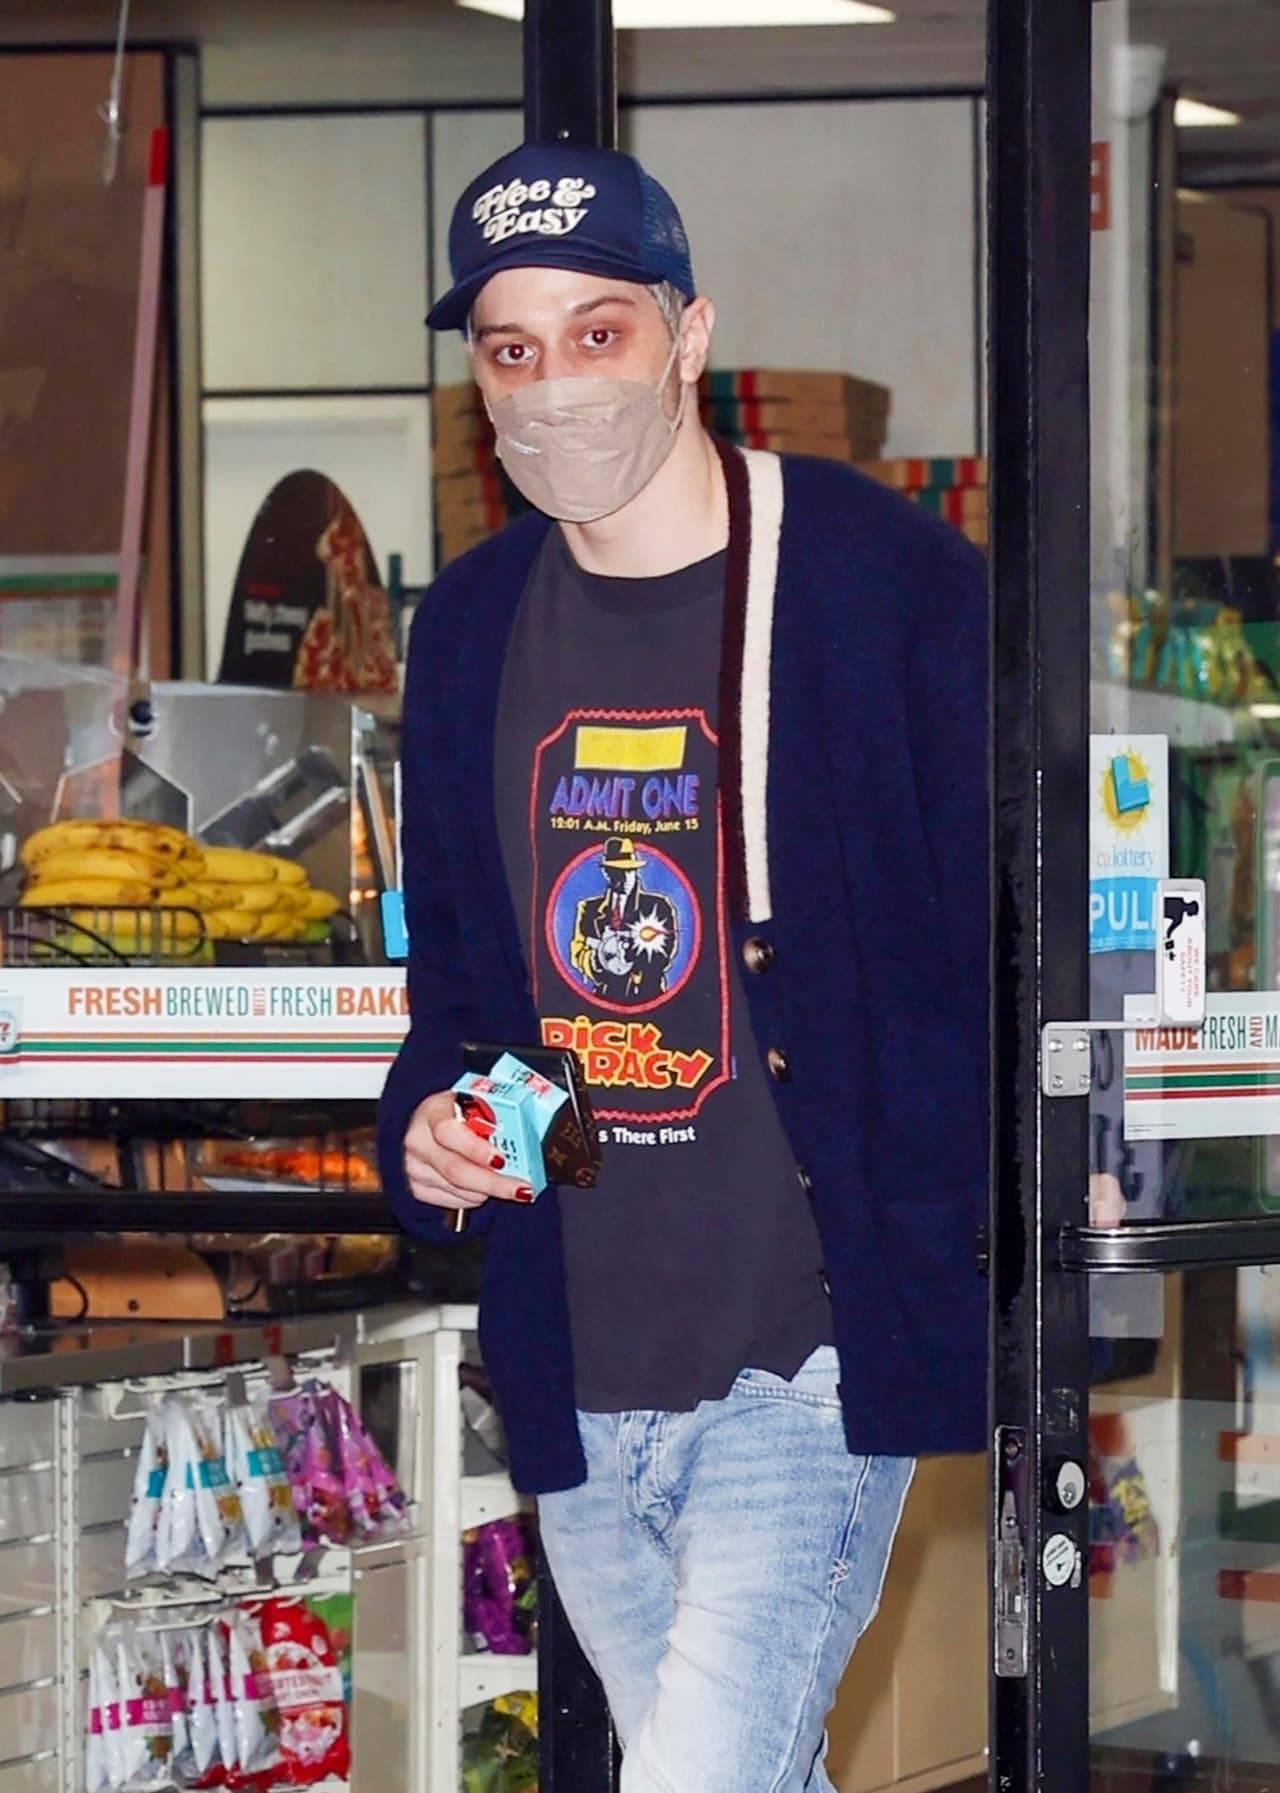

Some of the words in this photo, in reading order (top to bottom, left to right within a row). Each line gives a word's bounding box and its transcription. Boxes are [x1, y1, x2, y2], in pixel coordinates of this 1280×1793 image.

[472, 178, 551, 224] Free
[552, 177, 597, 207] &
[483, 208, 588, 245] Easy
[550, 774, 636, 818] ADMIT
[642, 773, 699, 818] ONE
[551, 817, 580, 829] 12:01
[583, 819, 611, 832] A.M.
[614, 818, 651, 834] Friday,
[655, 818, 681, 832] June
[684, 817, 698, 830] 15
[68, 987, 162, 1016] FRESH
[166, 987, 249, 1016] BREWED
[270, 987, 332, 1016] FRESH
[1201, 1015, 1246, 1049] FRESH
[578, 1049, 714, 1089] RACY
[611, 1127, 656, 1145] There
[659, 1126, 696, 1143] First
